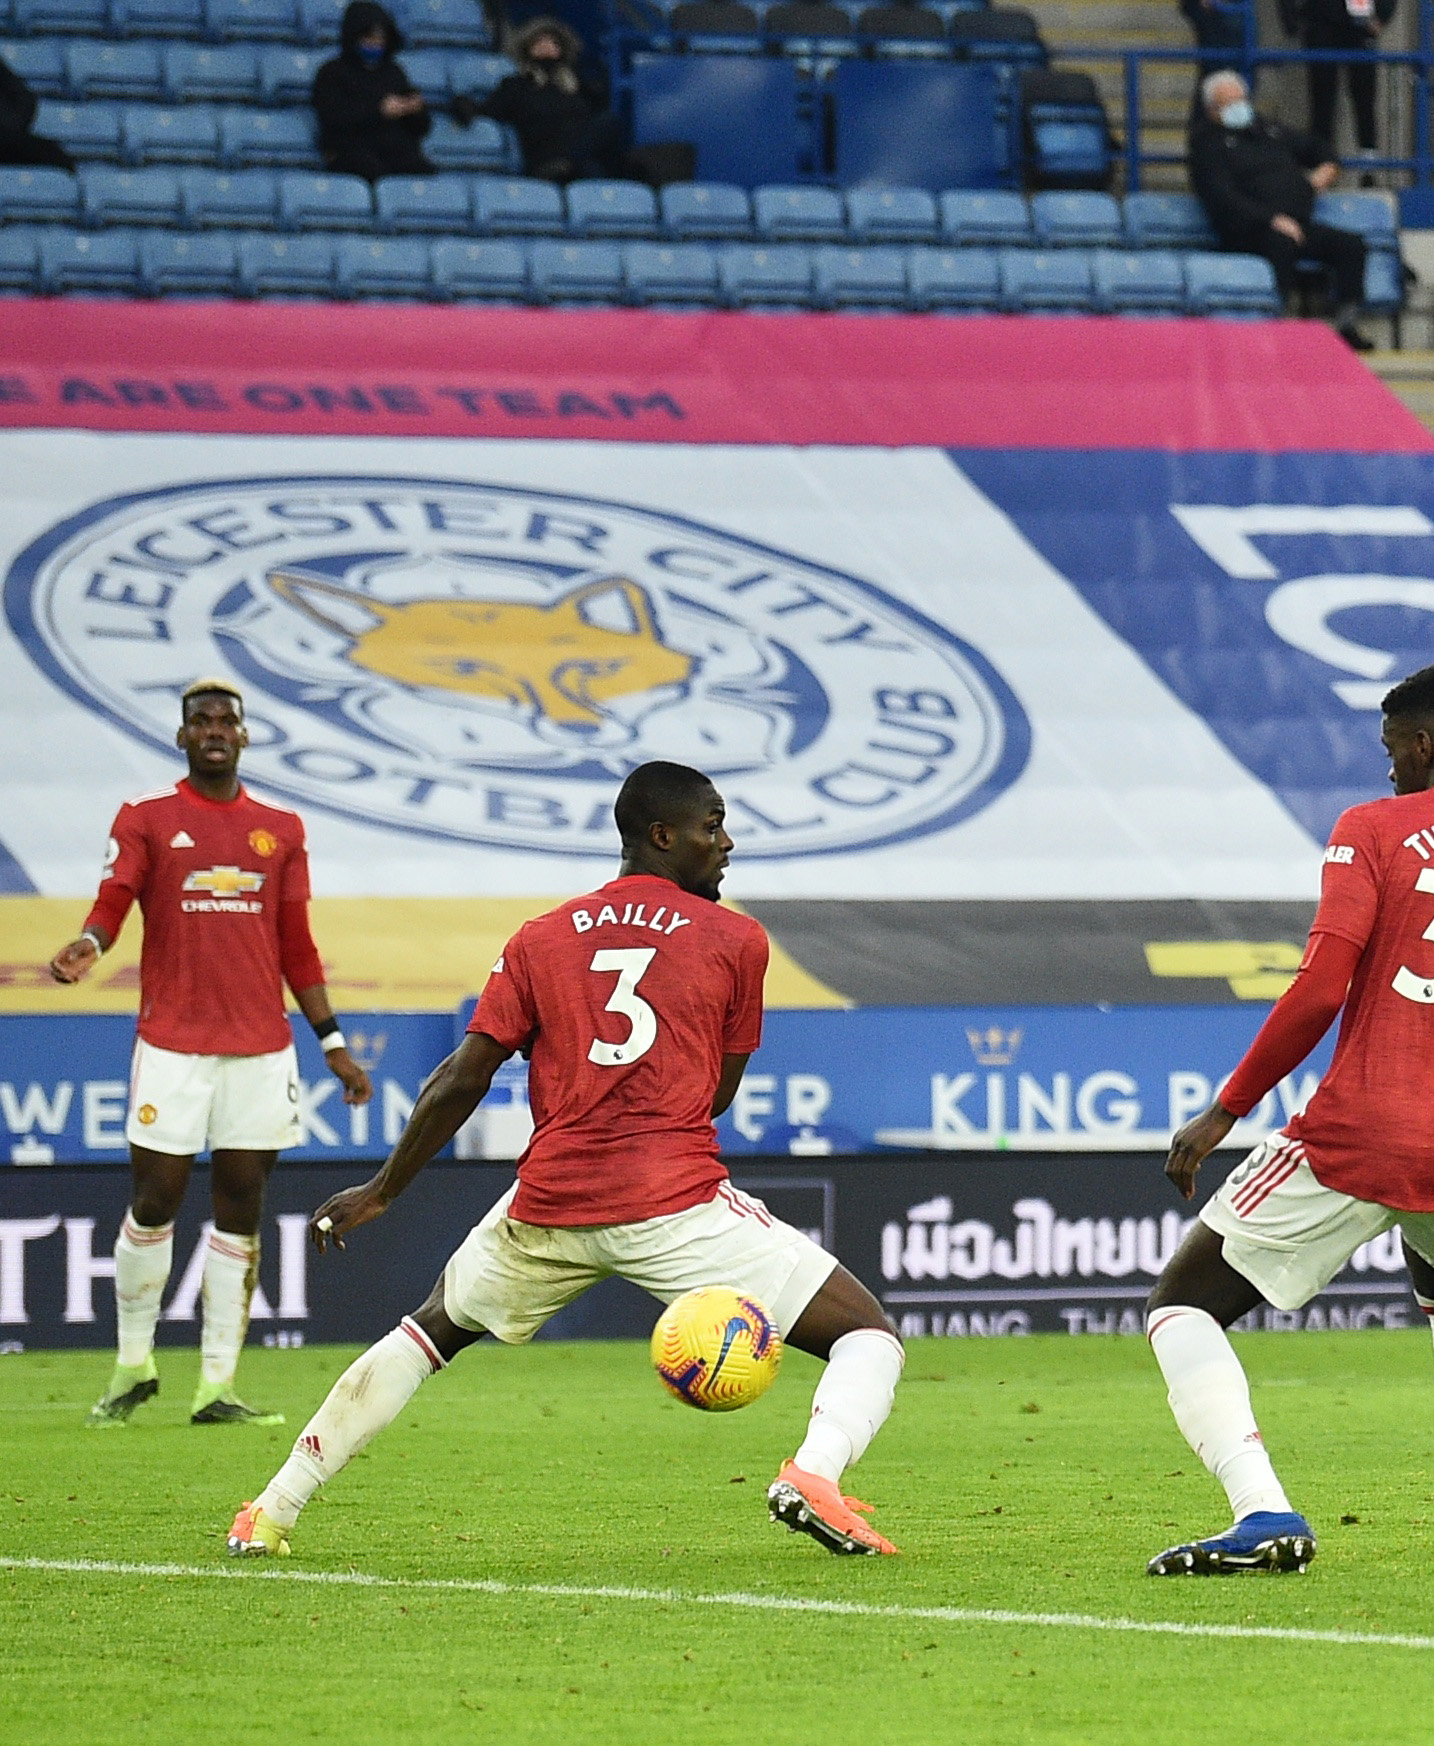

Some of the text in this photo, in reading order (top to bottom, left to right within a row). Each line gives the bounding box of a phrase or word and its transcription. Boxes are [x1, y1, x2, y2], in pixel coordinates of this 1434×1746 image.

[60, 377, 232, 412] ARE
[243, 381, 431, 416] ONE
[433, 384, 686, 421] TEAM
[84, 499, 917, 655] LEICESTER CITY
[808, 686, 961, 808] CLUB
[571, 902, 692, 937] BAILLY
[587, 946, 658, 1067] 3
[930, 1069, 1143, 1136] KING
